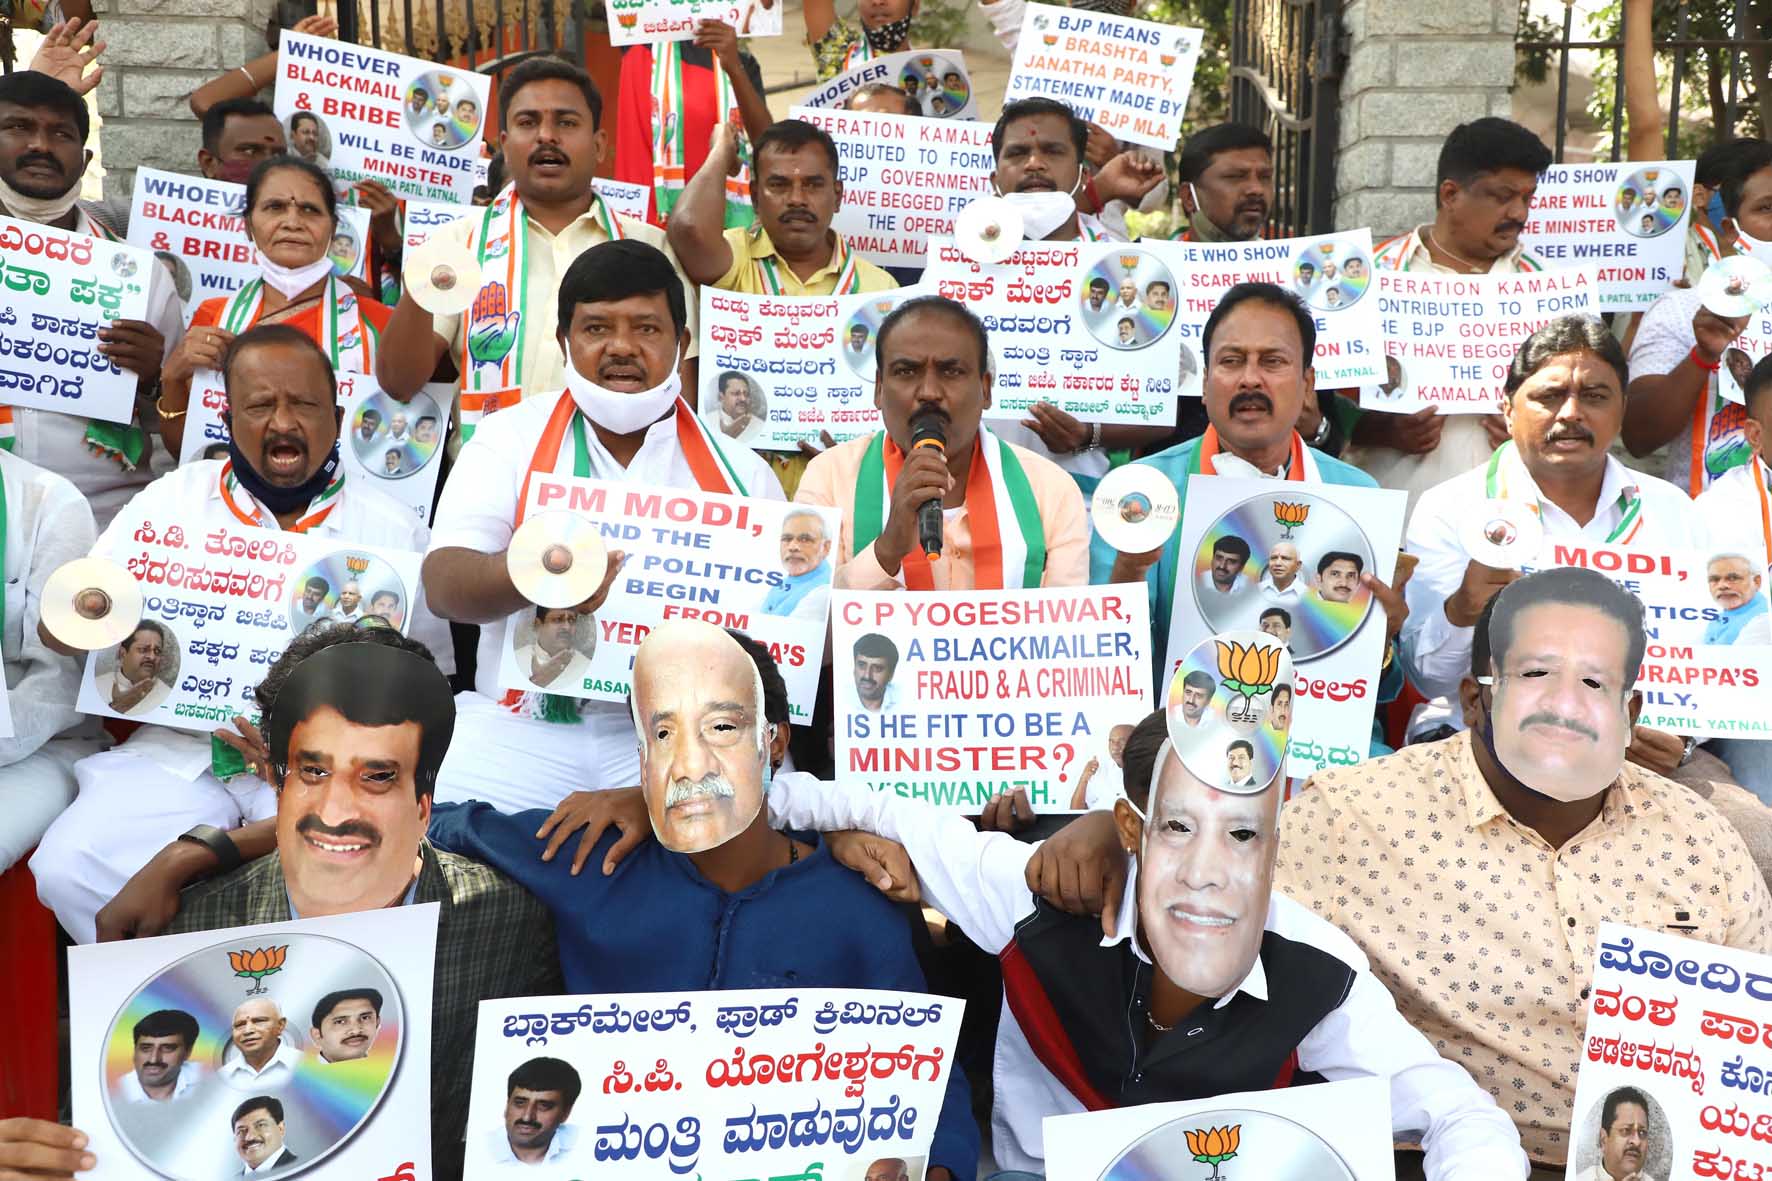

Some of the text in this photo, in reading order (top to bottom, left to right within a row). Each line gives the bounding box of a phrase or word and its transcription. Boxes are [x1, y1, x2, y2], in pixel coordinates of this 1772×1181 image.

[1058, 16, 1161, 46] BJP MEANS
[287, 40, 400, 78] WHOEVER
[1065, 36, 1148, 65] BRASHTA
[287, 64, 401, 101] BLACKMAIL
[806, 64, 888, 109] HOEVER
[1024, 54, 1173, 95] JANATHA PARTY,
[1013, 75, 1182, 117] STATEMENT MADE BY
[295, 92, 400, 128] & BRIBE
[920, 125, 993, 146] KAMALA
[1099, 110, 1130, 129] BJP
[1133, 117, 1170, 140] MLA.
[339, 132, 384, 153] WILL
[391, 144, 414, 160] BE
[421, 150, 472, 172] MADE
[919, 148, 938, 165] TO
[950, 152, 992, 170] FORM
[363, 157, 453, 187] MINISTER
[839, 166, 868, 182] BJP
[1536, 168, 1618, 185] WHO SHOW
[144, 177, 248, 209] WHOEV
[400, 180, 423, 196] PATIL
[1529, 194, 1607, 209] CARE WILL
[881, 194, 944, 211] BEGGED
[143, 201, 247, 233] BLACKMA
[868, 214, 896, 230] THE
[1520, 219, 1616, 234] HE MINISTER
[150, 232, 171, 251] &
[845, 235, 899, 253] AMALA
[1202, 248, 1238, 262] WHO
[1243, 245, 1290, 260] SHOW
[1534, 243, 1637, 258] SEE WHERE
[1380, 273, 1588, 296] PERATION KAMALA
[1597, 267, 1671, 283] ATION IS,
[1007, 277, 1072, 304] ಮೇಲ್
[1607, 293, 1633, 304] PATIL
[711, 296, 839, 325] ದುಡ್ಡು ಕೊಟ್ಟವರಿಗೆ
[1187, 298, 1215, 313] THE
[1379, 293, 1589, 317] ONTRIBUTED TO FORM
[711, 323, 835, 351] ಬ್ಲಾಕ್ ಮೇಲ್
[1381, 320, 1397, 335] HE
[1413, 322, 1444, 337] BJP
[1003, 345, 1099, 370] ಮಂತ್ರಿ ಸ್ಥಾನ
[1347, 340, 1369, 355] IS,
[1413, 343, 1457, 358] HAVE
[1463, 343, 1520, 358] BEGGE
[716, 354, 836, 375] ಮಾಡಿದವರಿಗೆ
[1451, 365, 1482, 380] THE
[774, 385, 863, 405] ಮಂತ್ರಿ ಸ್ಥಾನ
[999, 370, 1171, 401] ಇದು ಬಿಜೆಪಿ ಸರ್ಕಾರದ ಕೆಟ್ಟ ನೀತಿ
[1417, 386, 1489, 401] KAMALA
[770, 409, 792, 422] ಇದು
[537, 482, 764, 538] PM MODI,
[204, 528, 298, 567] ತೋರಿಸಿ
[652, 527, 713, 550] THE
[643, 554, 792, 592] POLITICS,
[1554, 545, 1689, 581] MODI,
[127, 551, 285, 603] ಬೆದರಿಸುವವರಿಗೆ
[625, 578, 721, 605] BEGIN
[236, 608, 289, 631] ಬಿಜೆಪಿ
[662, 604, 749, 631] FROM
[843, 596, 1132, 626] C P YOGESHWAR,
[188, 637, 240, 666] ಪಕ್ಷದ
[906, 632, 1140, 662] A BLACKMAILER,
[181, 674, 232, 702] ಎಲ್ಲಿಗೆ
[917, 665, 1144, 701] FRAUD & A CRIMINAL,
[847, 711, 1092, 738] IS HE FIT TO BE A
[1657, 715, 1701, 729] PATIL
[715, 997, 799, 1039] ಫ್ರಾಡ್
[813, 998, 943, 1036] ಕ್ರಿಮಿನಲ್
[1594, 984, 1679, 1027] ವಂಶ
[601, 1058, 683, 1096] ಸಿ.ಪಿ.
[1587, 1031, 1705, 1096] ಆಡಳಿತವನ್ನು
[592, 1093, 919, 1175] ಮಂತ್ರಿ ಮಾಡುವುದೇ
